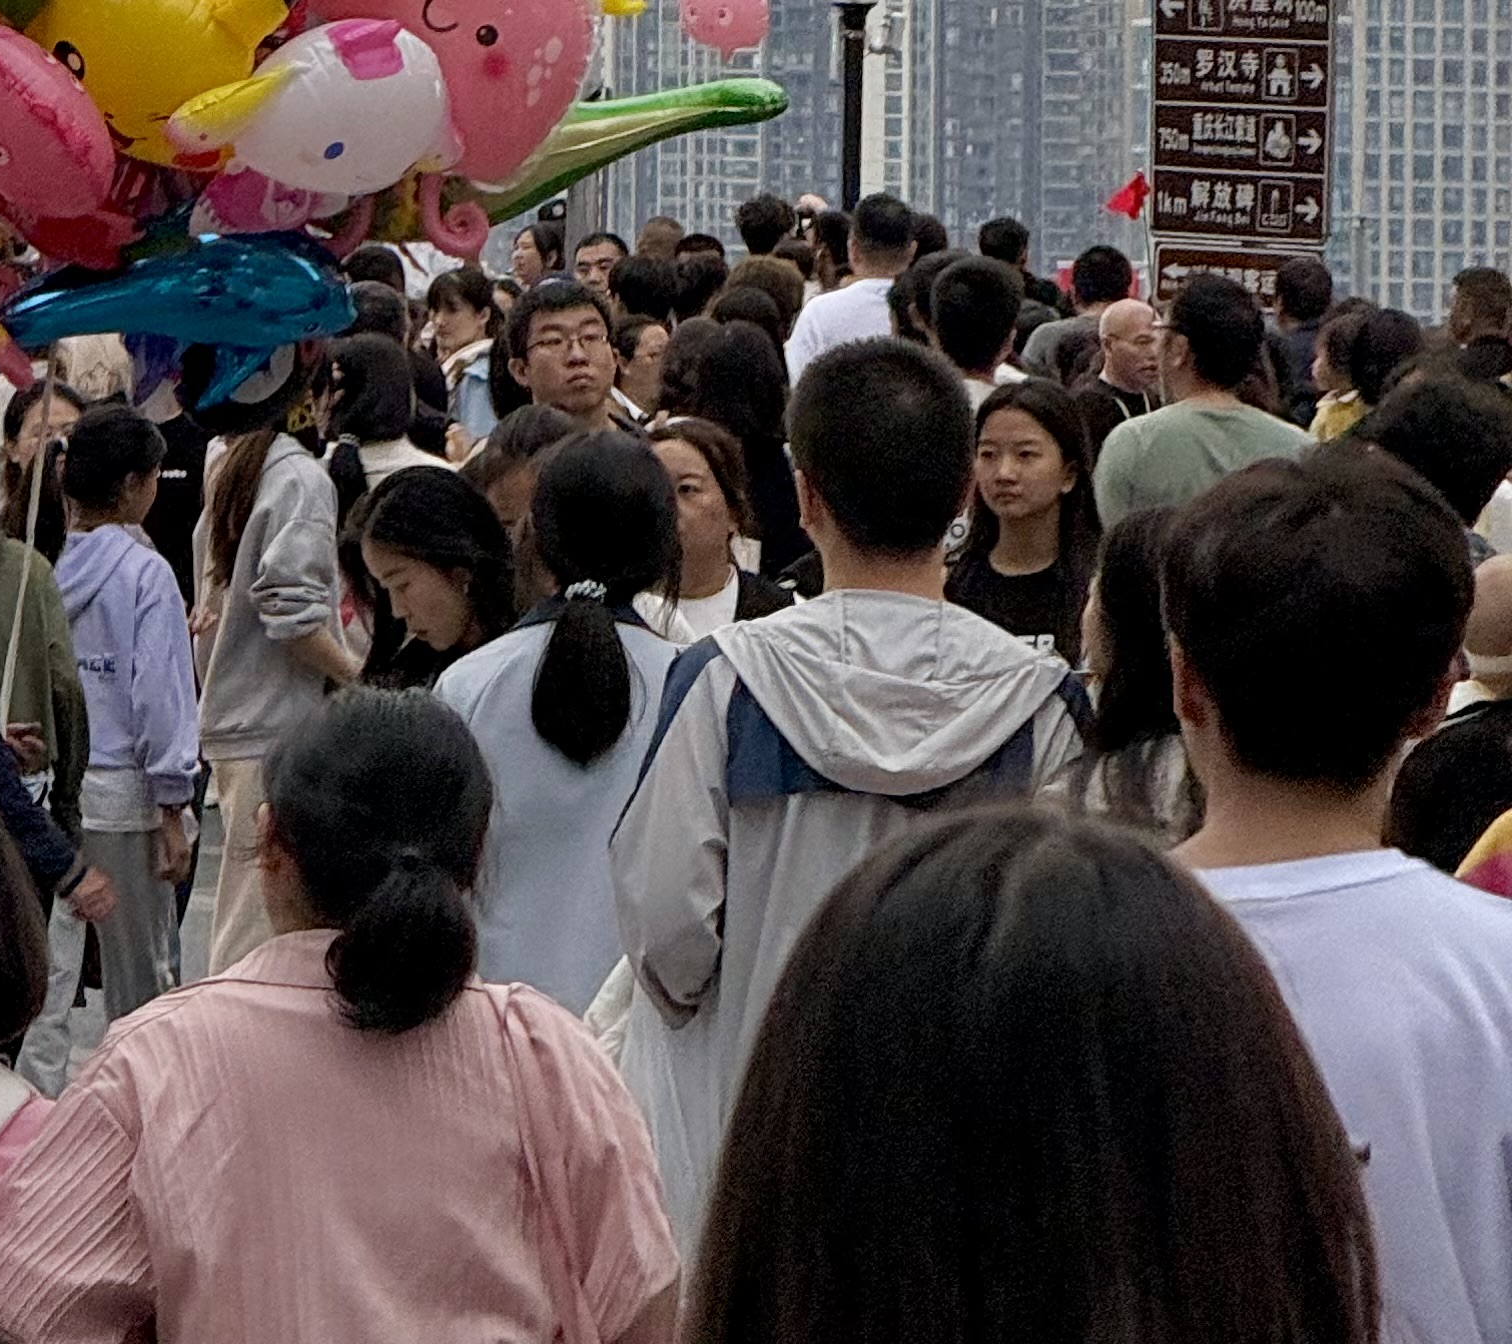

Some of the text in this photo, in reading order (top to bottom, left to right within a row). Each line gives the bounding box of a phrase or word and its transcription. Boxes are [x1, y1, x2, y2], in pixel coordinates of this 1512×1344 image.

[1295, 0, 1328, 23] 100m
[1159, 47, 1260, 86] 350m 罗汉寺
[1157, 126, 1190, 152] 750m
[1156, 178, 1256, 215] 1km 解放碑
